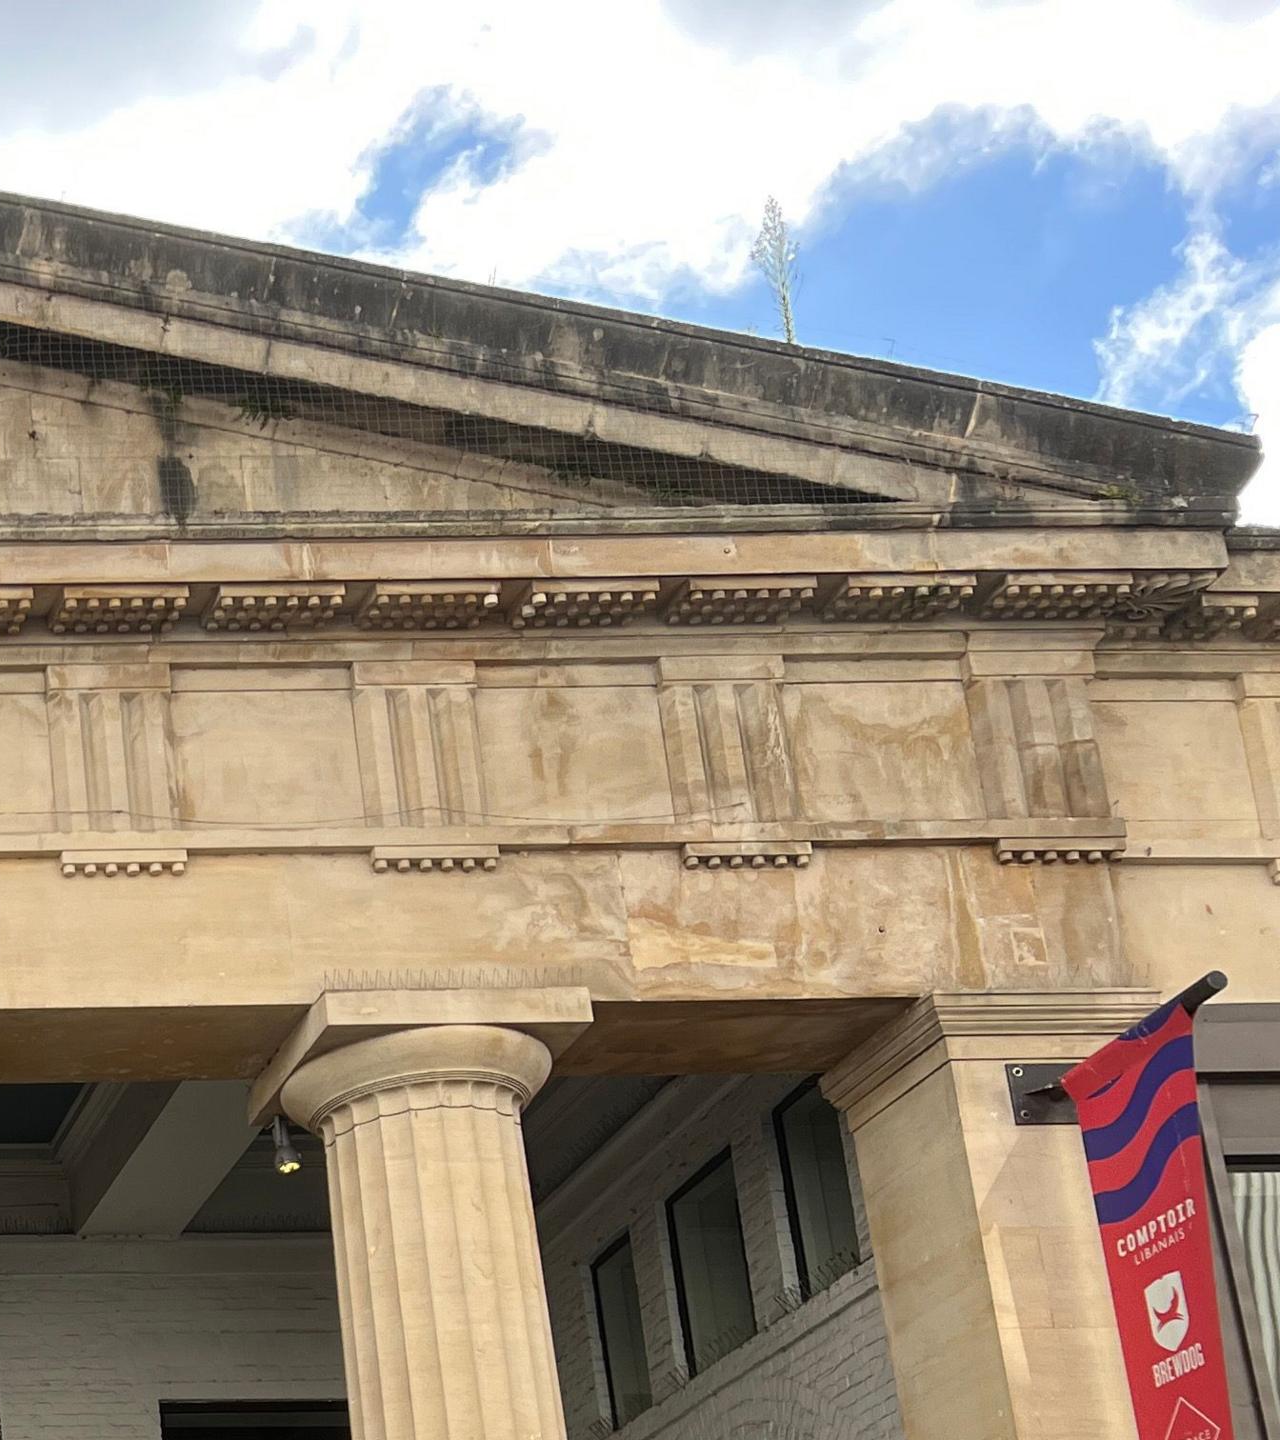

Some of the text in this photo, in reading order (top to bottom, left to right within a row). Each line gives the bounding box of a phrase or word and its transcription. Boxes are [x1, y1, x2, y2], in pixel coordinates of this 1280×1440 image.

[1117, 1198, 1196, 1258] COMPTOIR
[1134, 1227, 1186, 1266] LIBANAIS
[1152, 1342, 1206, 1389] BREWDOG
